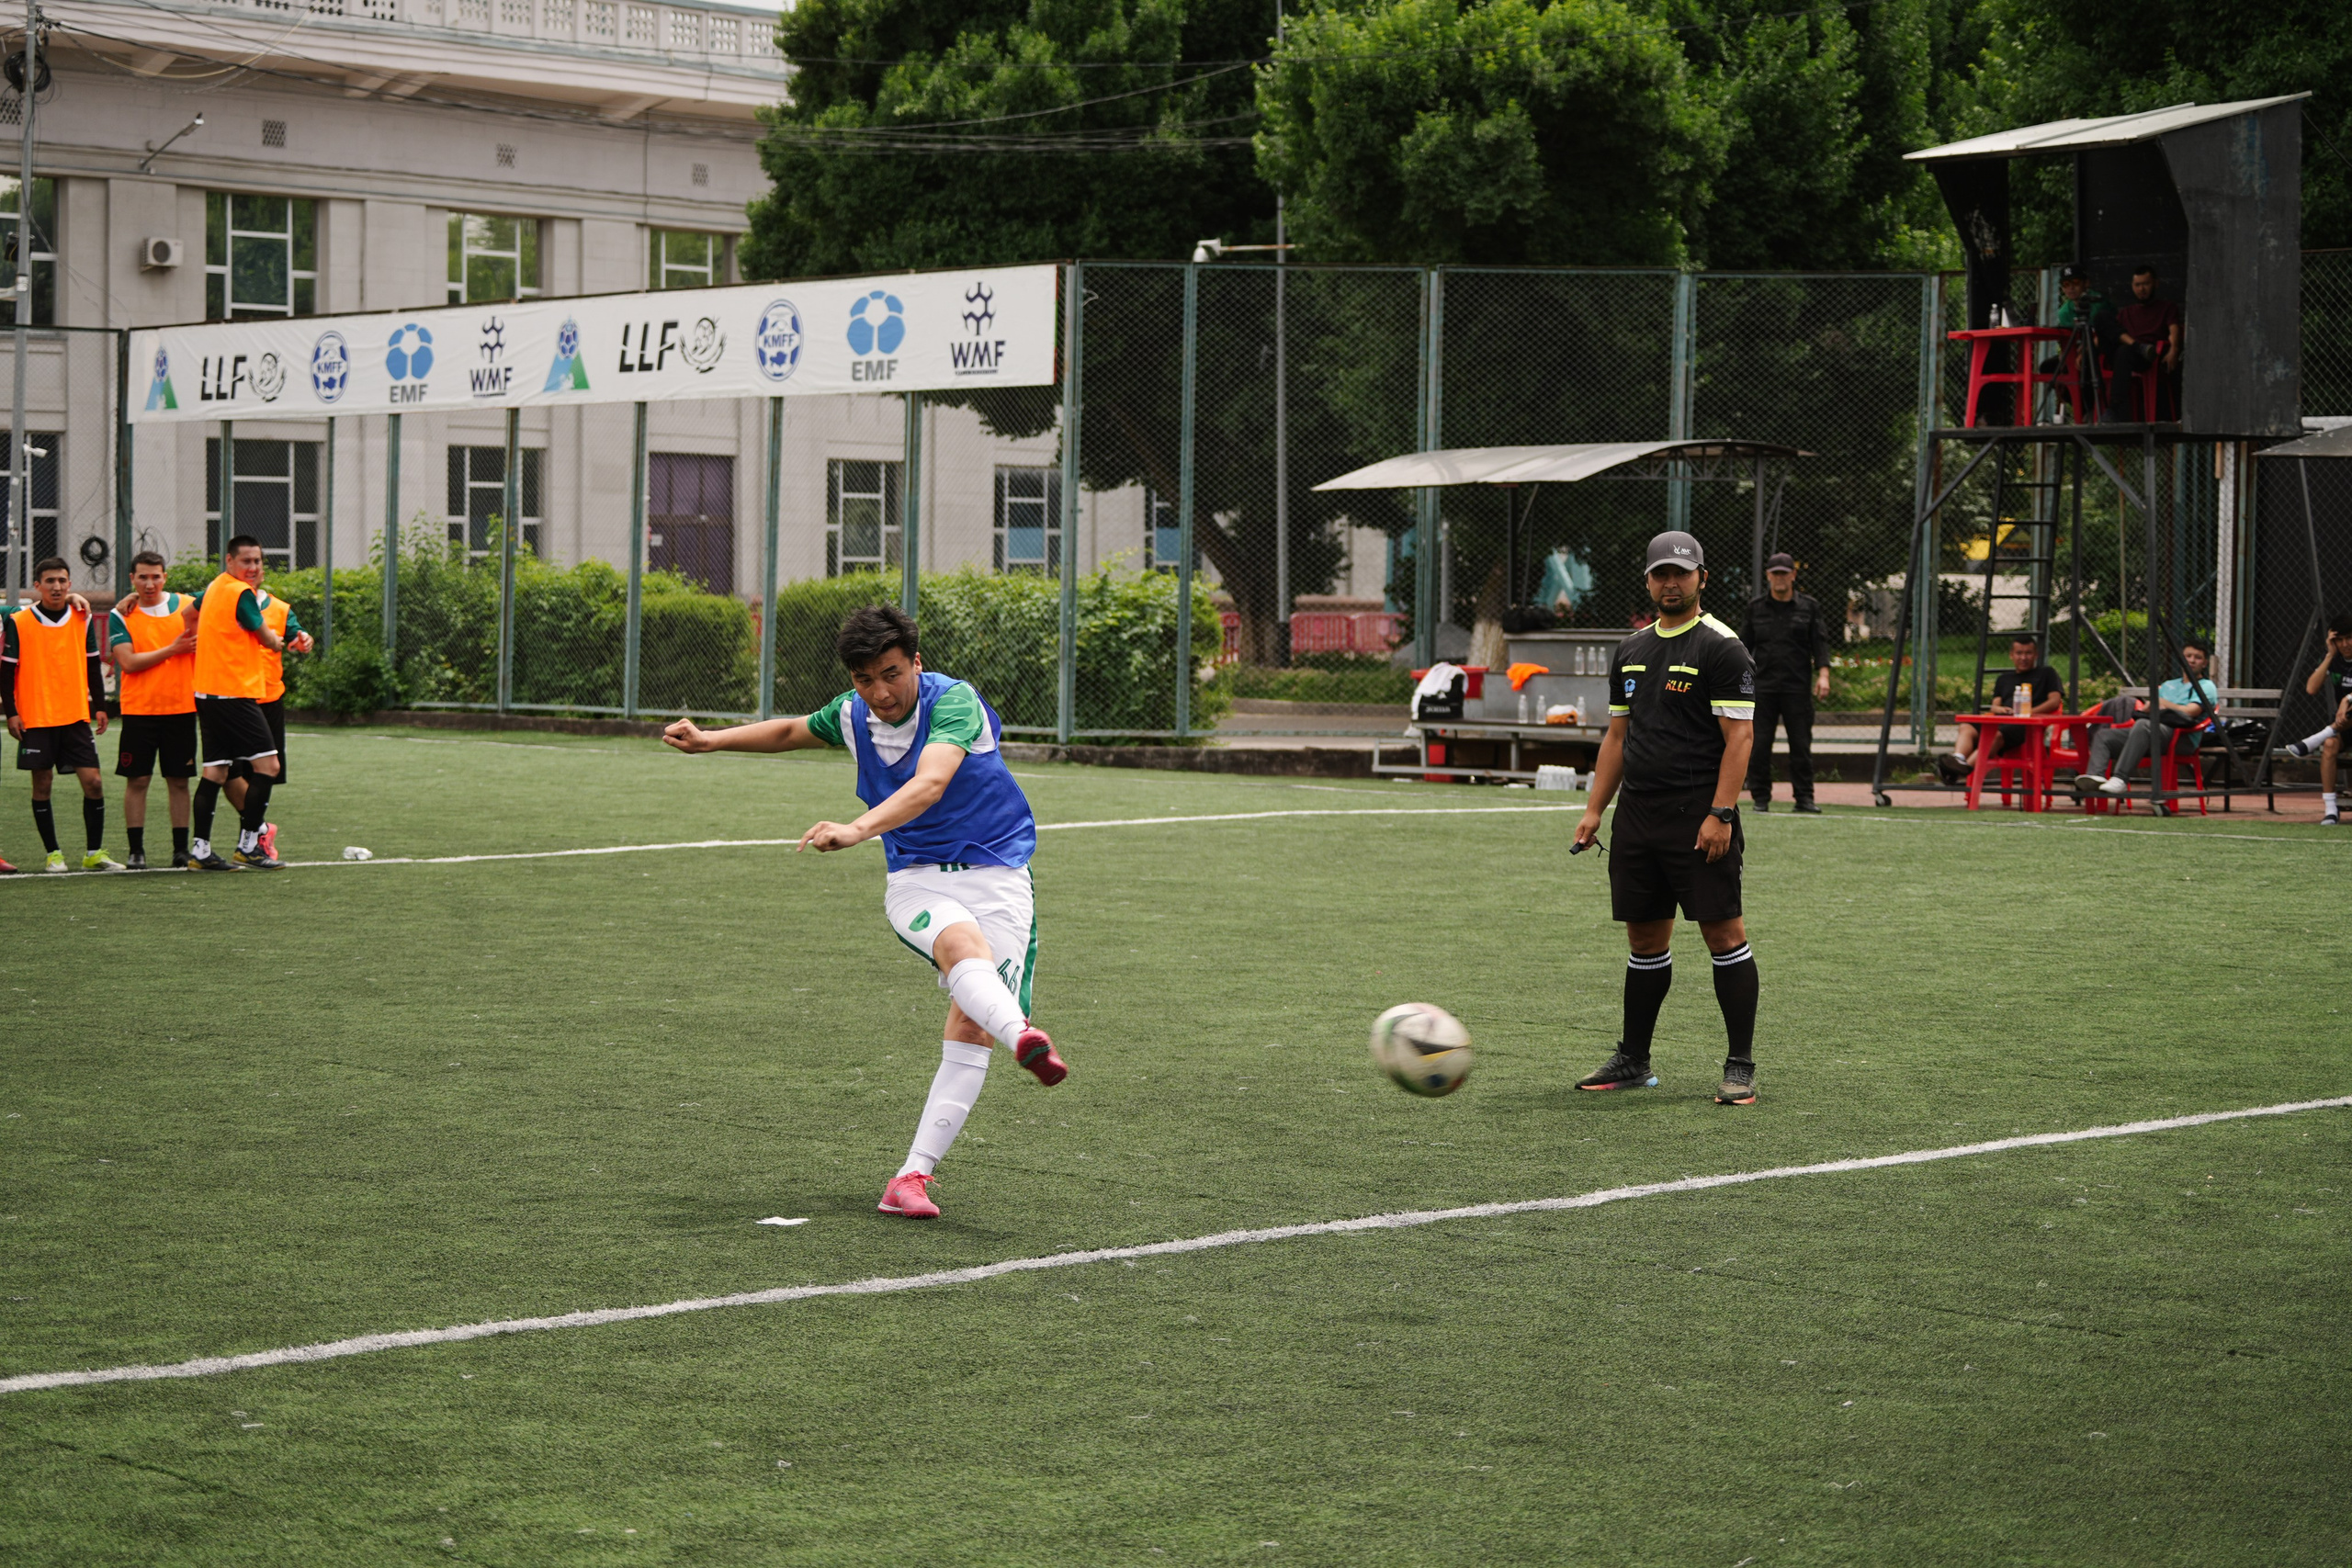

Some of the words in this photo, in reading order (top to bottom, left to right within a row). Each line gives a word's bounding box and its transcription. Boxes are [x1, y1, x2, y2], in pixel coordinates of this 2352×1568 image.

[618, 321, 679, 372] LLF
[763, 333, 796, 347] KMFF
[951, 341, 1006, 368] WMF
[200, 355, 247, 400] LLF
[317, 361, 344, 374] KMFF
[852, 359, 899, 381] EMF
[469, 367, 513, 392] WMF
[390, 384, 428, 403] EMF
